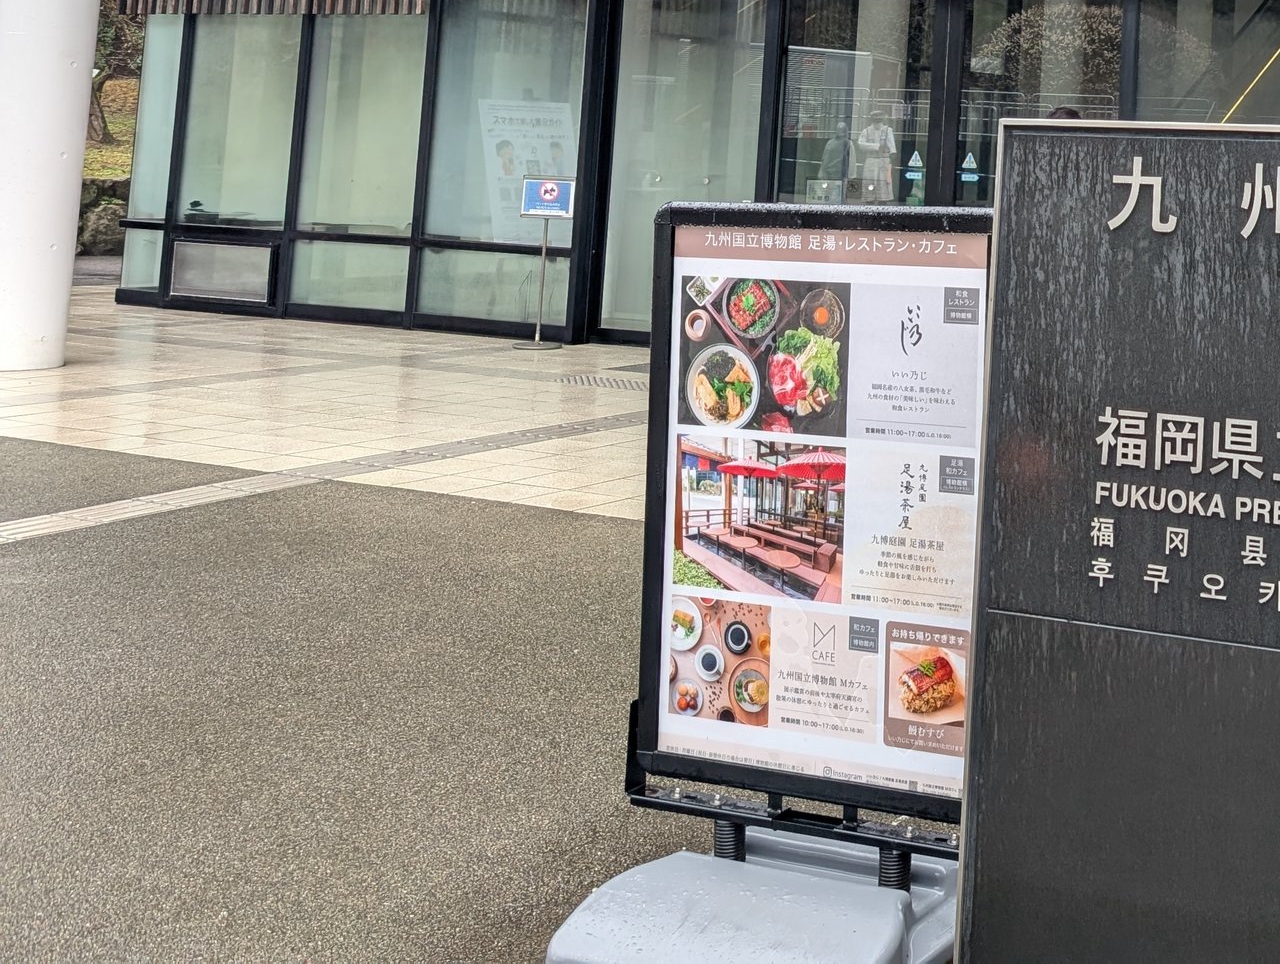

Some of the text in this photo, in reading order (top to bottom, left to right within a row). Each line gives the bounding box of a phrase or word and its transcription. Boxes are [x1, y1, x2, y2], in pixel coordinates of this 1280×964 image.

[704, 231, 958, 255] 九州国立博物館 足湯・レストラン・カフェ
[955, 290, 969, 298] 和食
[948, 298, 975, 307] レストラン
[892, 404, 930, 413] 和食レストラン
[865, 427, 886, 435] 営業時間
[945, 467, 968, 476] 和カフェ
[1095, 481, 1226, 519] FUKUOKA
[909, 537, 945, 552] 足湯茶屋
[851, 593, 872, 602] 営業時間
[853, 623, 877, 633] 和カフェ
[891, 628, 965, 646] お持ち帰りできます
[811, 650, 836, 663] CAFE
[777, 669, 869, 691] 九州国立博物館 Mカフェ
[780, 716, 801, 725] 営業時間
[908, 724, 945, 739] 鰻むすび
[832, 770, 863, 782] Instagram
